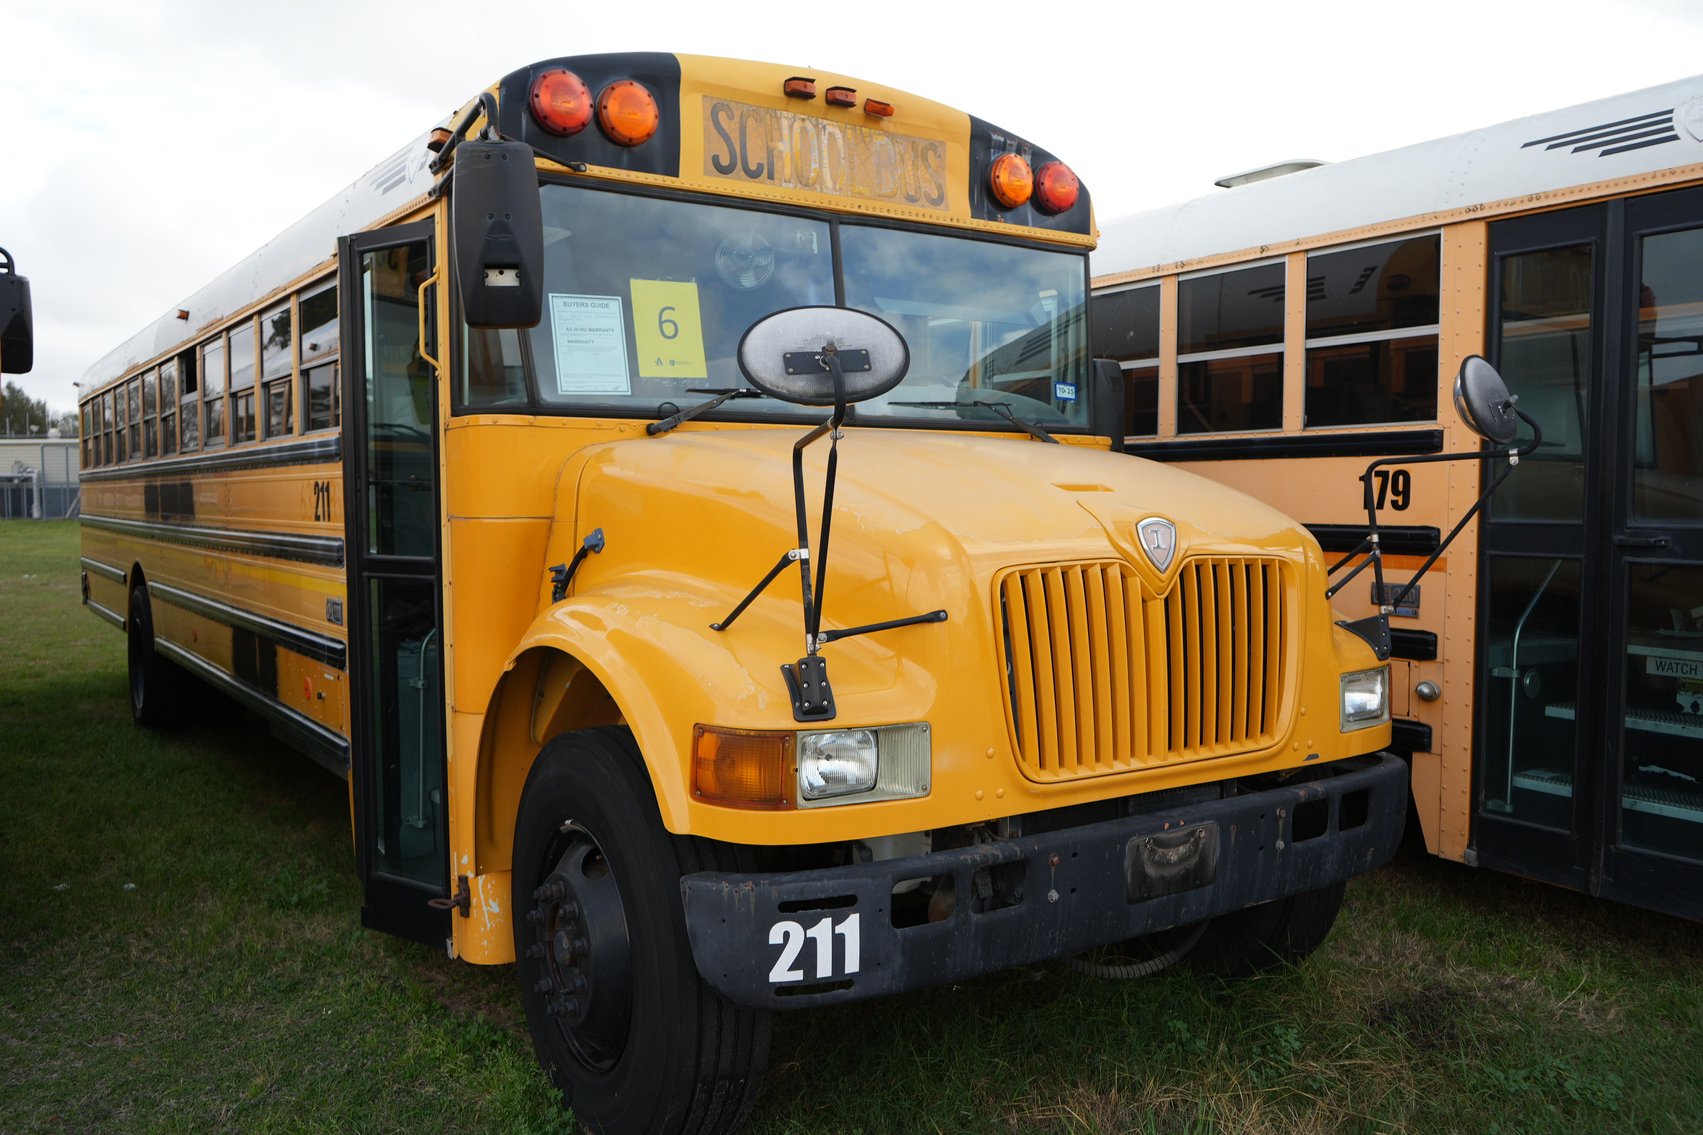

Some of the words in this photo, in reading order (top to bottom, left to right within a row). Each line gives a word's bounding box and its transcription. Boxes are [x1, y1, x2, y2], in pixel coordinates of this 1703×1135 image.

[873, 134, 945, 207] BUS
[562, 301, 589, 309] BUYERS
[658, 306, 679, 340] 6
[313, 480, 331, 522] 211
[1655, 660, 1698, 676] WATCH
[768, 912, 860, 983] 211
